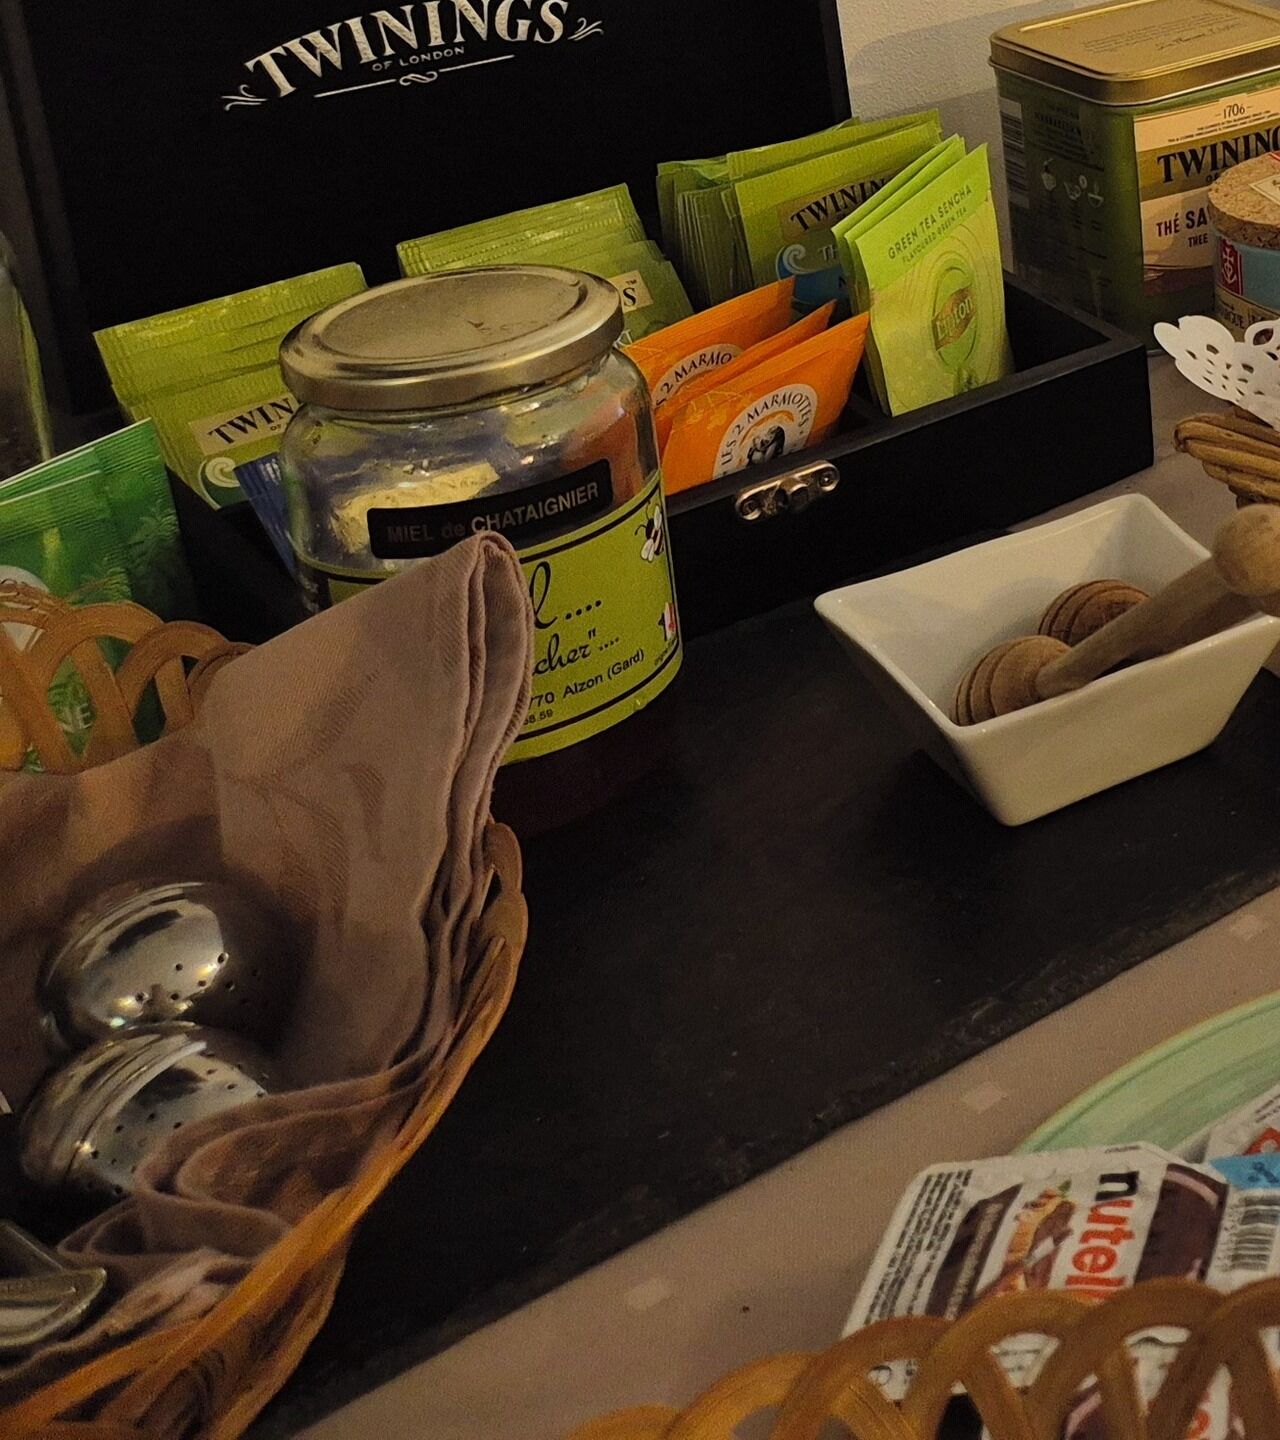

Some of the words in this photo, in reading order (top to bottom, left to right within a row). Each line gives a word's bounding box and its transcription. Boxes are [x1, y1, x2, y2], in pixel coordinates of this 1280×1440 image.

[371, 61, 393, 72] OF
[399, 46, 465, 66] LONDON
[888, 227, 918, 260] GREEN
[919, 214, 937, 232] TEA
[937, 184, 972, 218] SENCHA
[1156, 212, 1180, 238] THÉ
[660, 382, 674, 394] 2
[673, 351, 737, 383] MARMO
[207, 397, 295, 444] TWIN
[732, 423, 745, 436] 2
[746, 391, 812, 428] MARMOTTES
[386, 523, 433, 544] MIEL
[440, 523, 467, 539] de
[471, 481, 599, 534] CHATAIGNIER
[562, 673, 604, 699] Alzon
[607, 648, 646, 681] (Gard)
[1064, 1170, 1140, 1304] nutell
